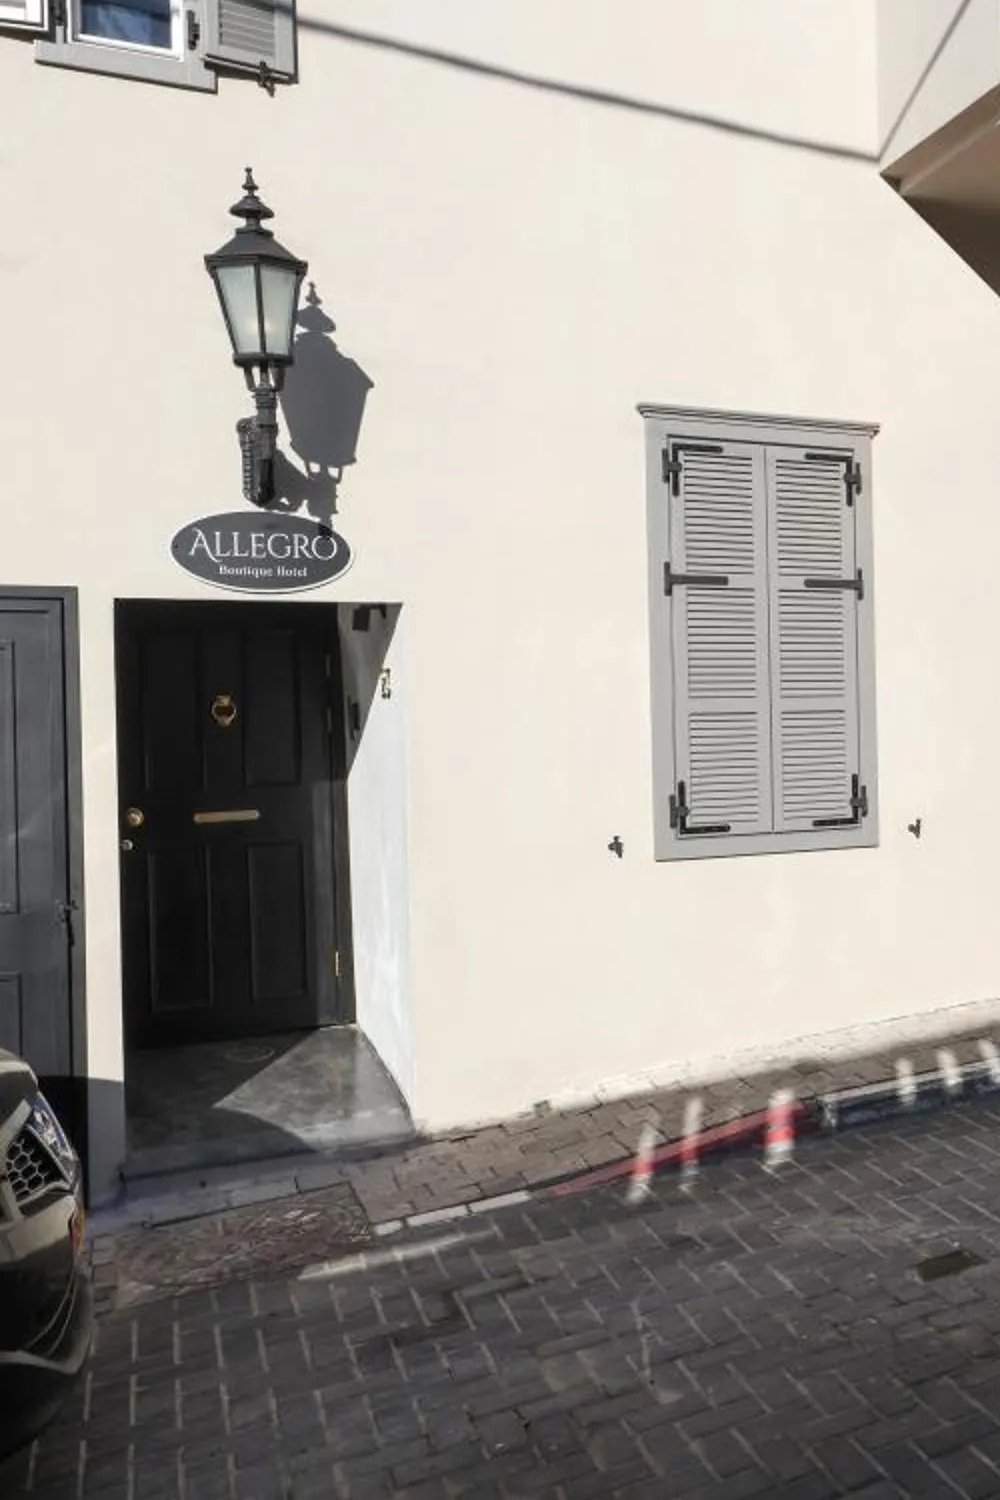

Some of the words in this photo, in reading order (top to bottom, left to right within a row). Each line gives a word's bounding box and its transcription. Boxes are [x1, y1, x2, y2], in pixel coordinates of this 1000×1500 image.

[189, 527, 337, 562] ALLEGRO
[219, 565, 273, 578] Boutique
[277, 566, 308, 577] Hotel
